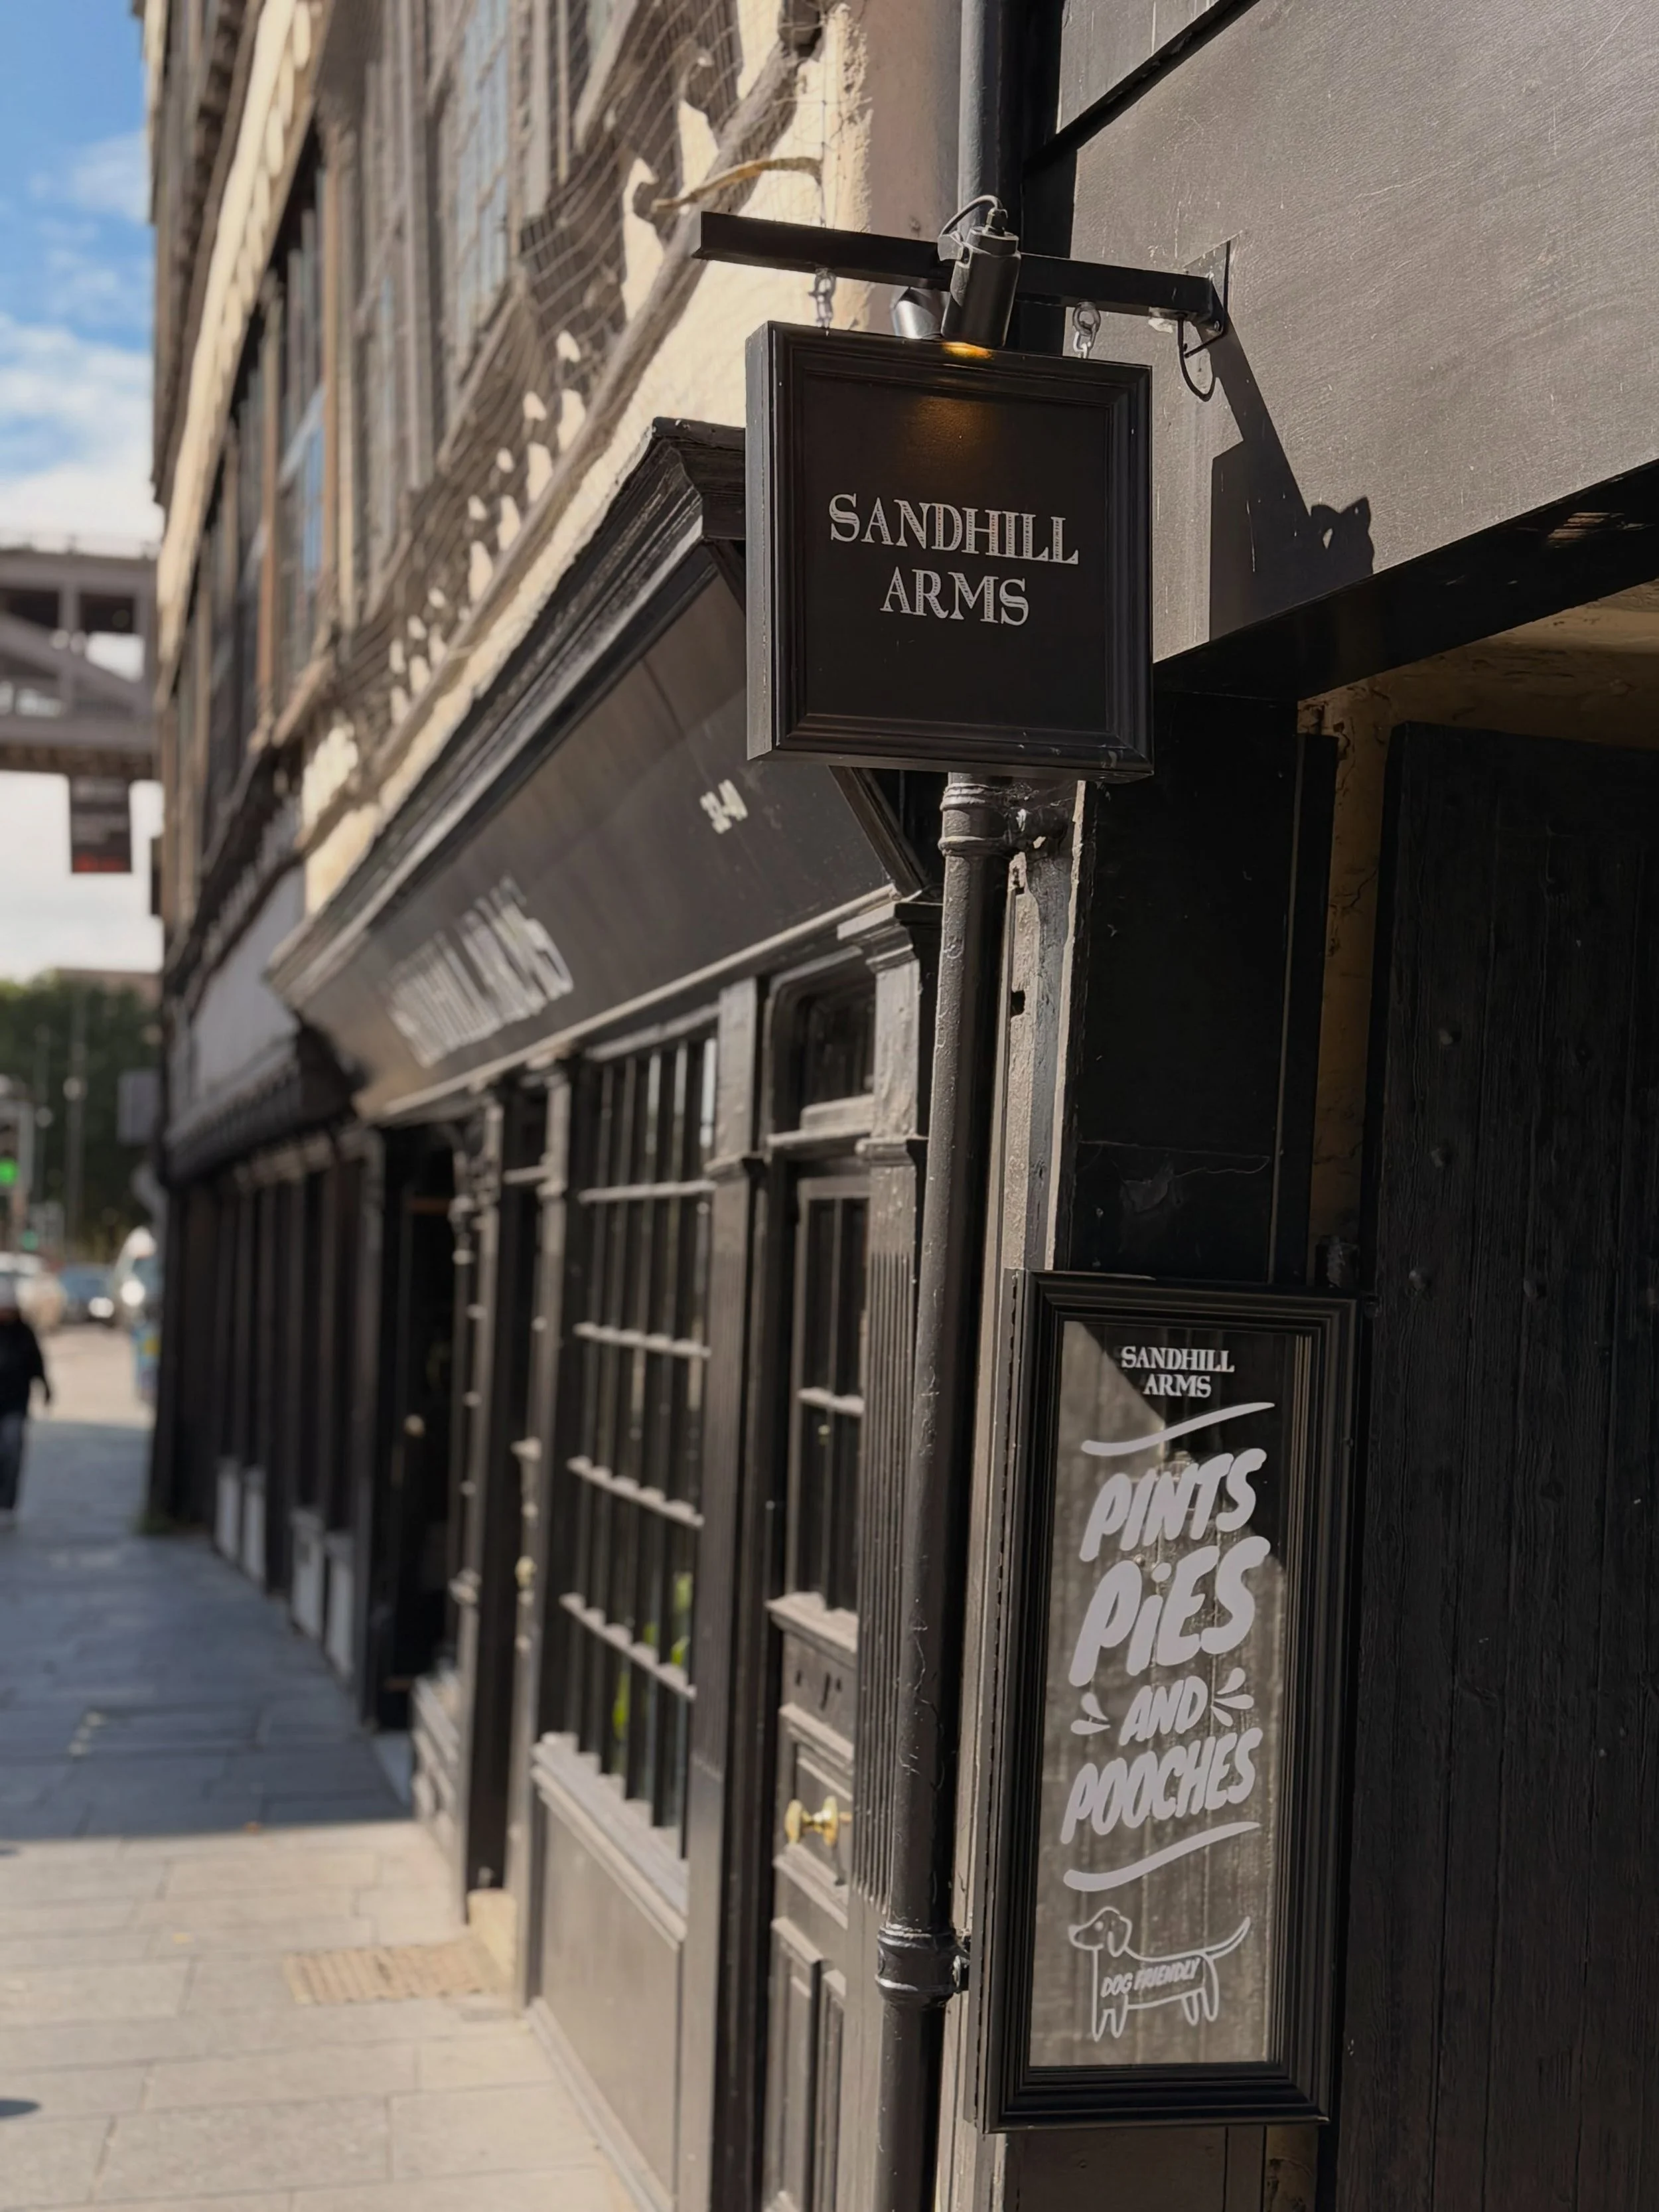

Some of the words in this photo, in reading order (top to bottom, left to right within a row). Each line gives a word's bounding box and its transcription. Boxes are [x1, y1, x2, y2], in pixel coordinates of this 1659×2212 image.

[829, 493, 1079, 565] SANDHILL
[880, 566, 1030, 626] ARMS
[1121, 1346, 1235, 1372] SANDHILL
[1143, 1374, 1212, 1398] ARMS
[1079, 1447, 1267, 1562] PINTS
[1119, 1675, 1208, 1746] AND
[1060, 1727, 1263, 1845] POOCHES
[1100, 1972, 1133, 1998] DOG
[1133, 1957, 1201, 1990] FRIENDLY
